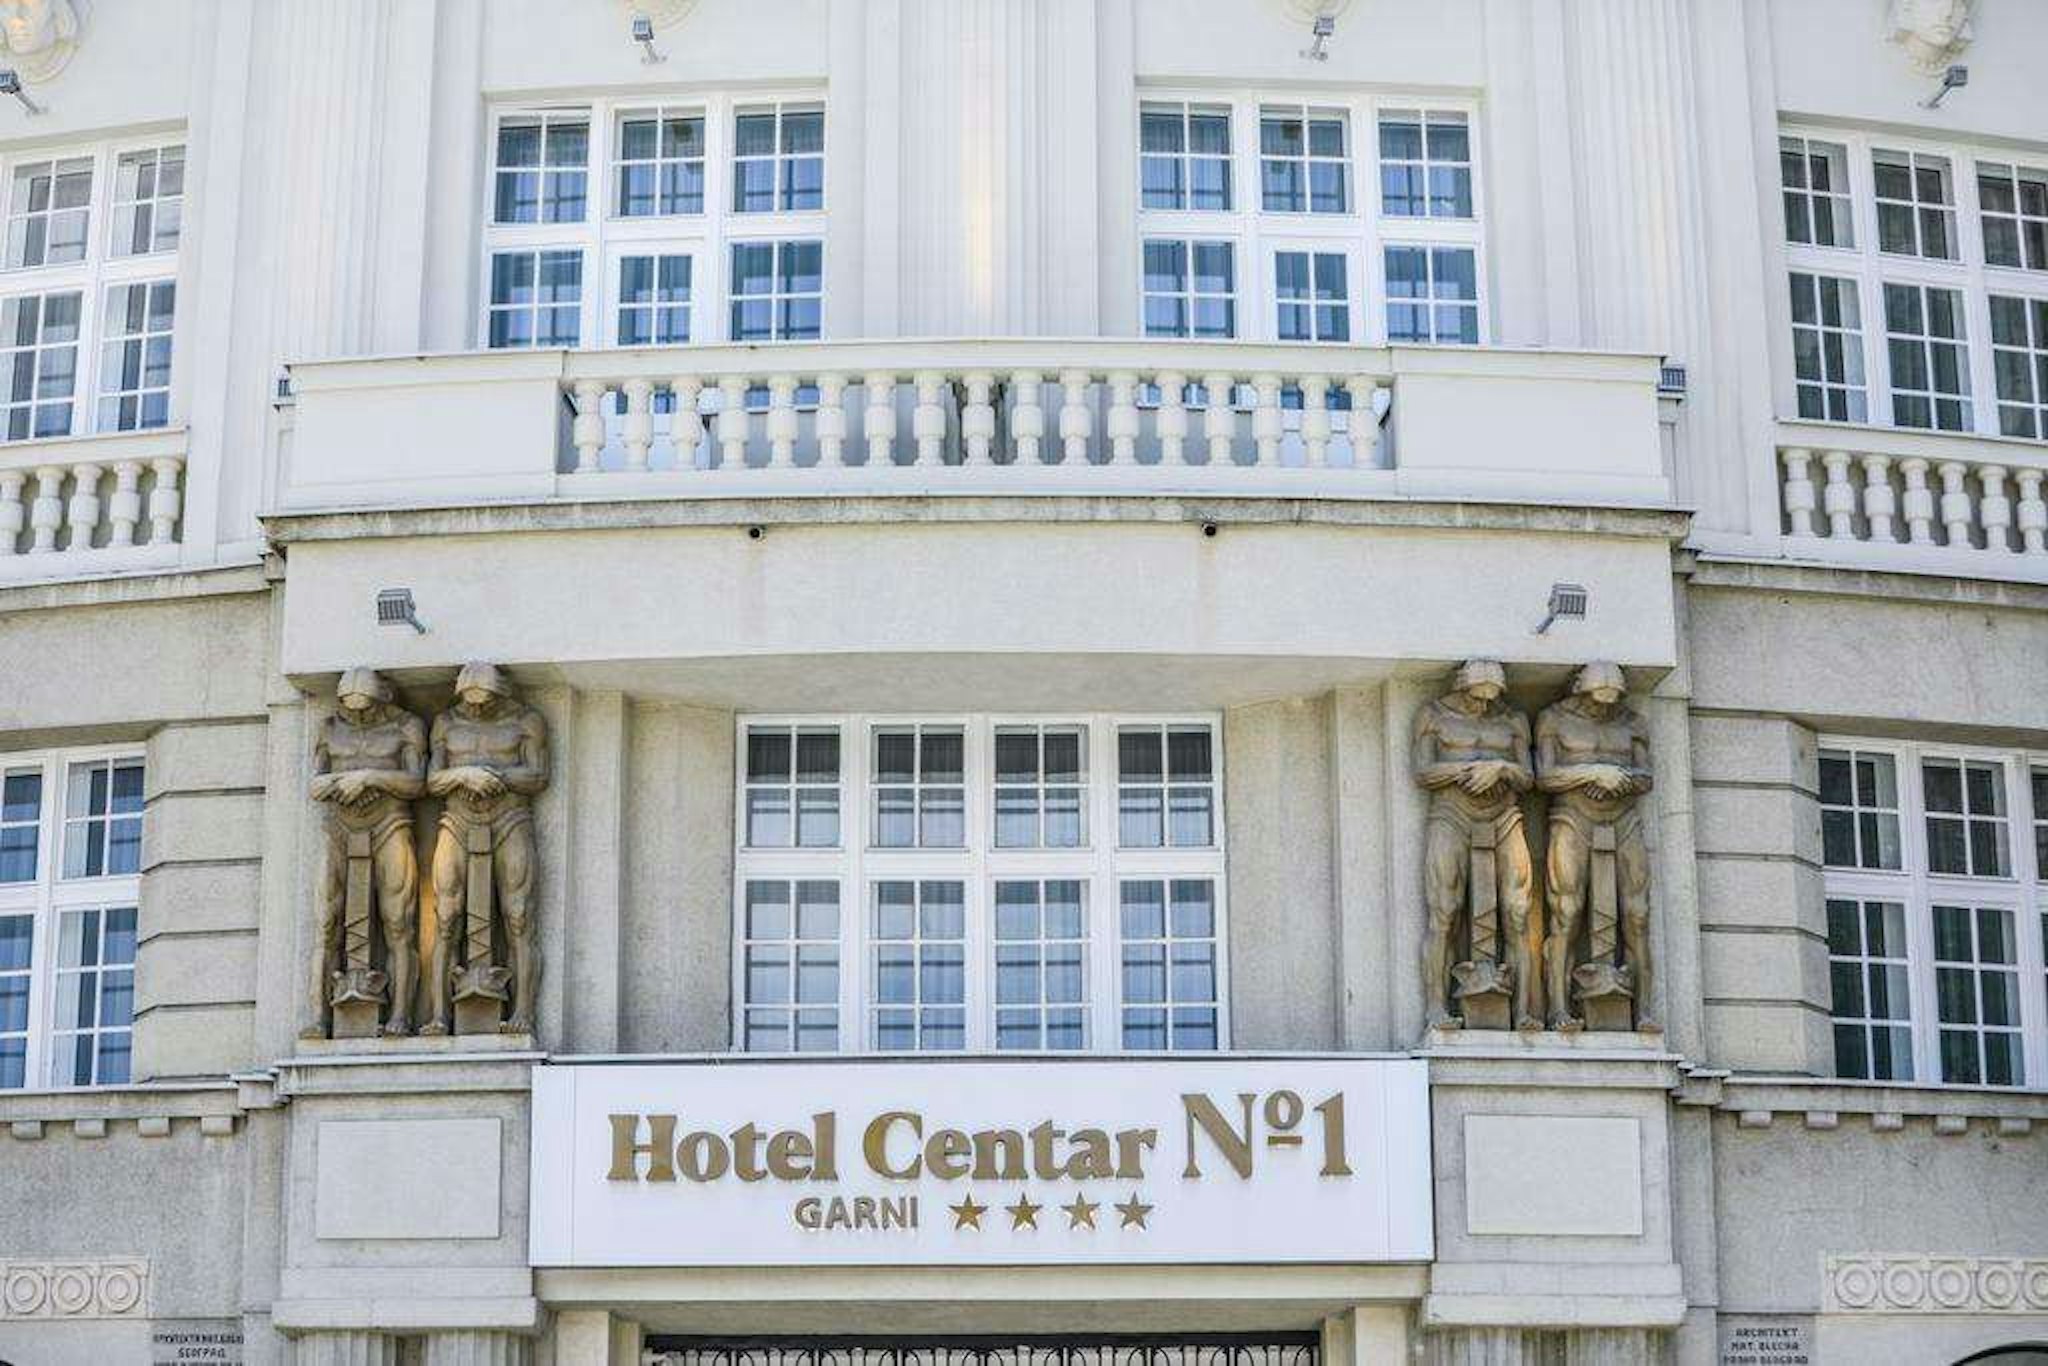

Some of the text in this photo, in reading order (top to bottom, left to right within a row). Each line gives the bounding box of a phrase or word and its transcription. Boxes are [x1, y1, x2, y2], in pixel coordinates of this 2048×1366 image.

[607, 1112, 838, 1182] Hotel
[863, 1112, 1157, 1182] Centar
[794, 1197, 919, 1230] GARNI
